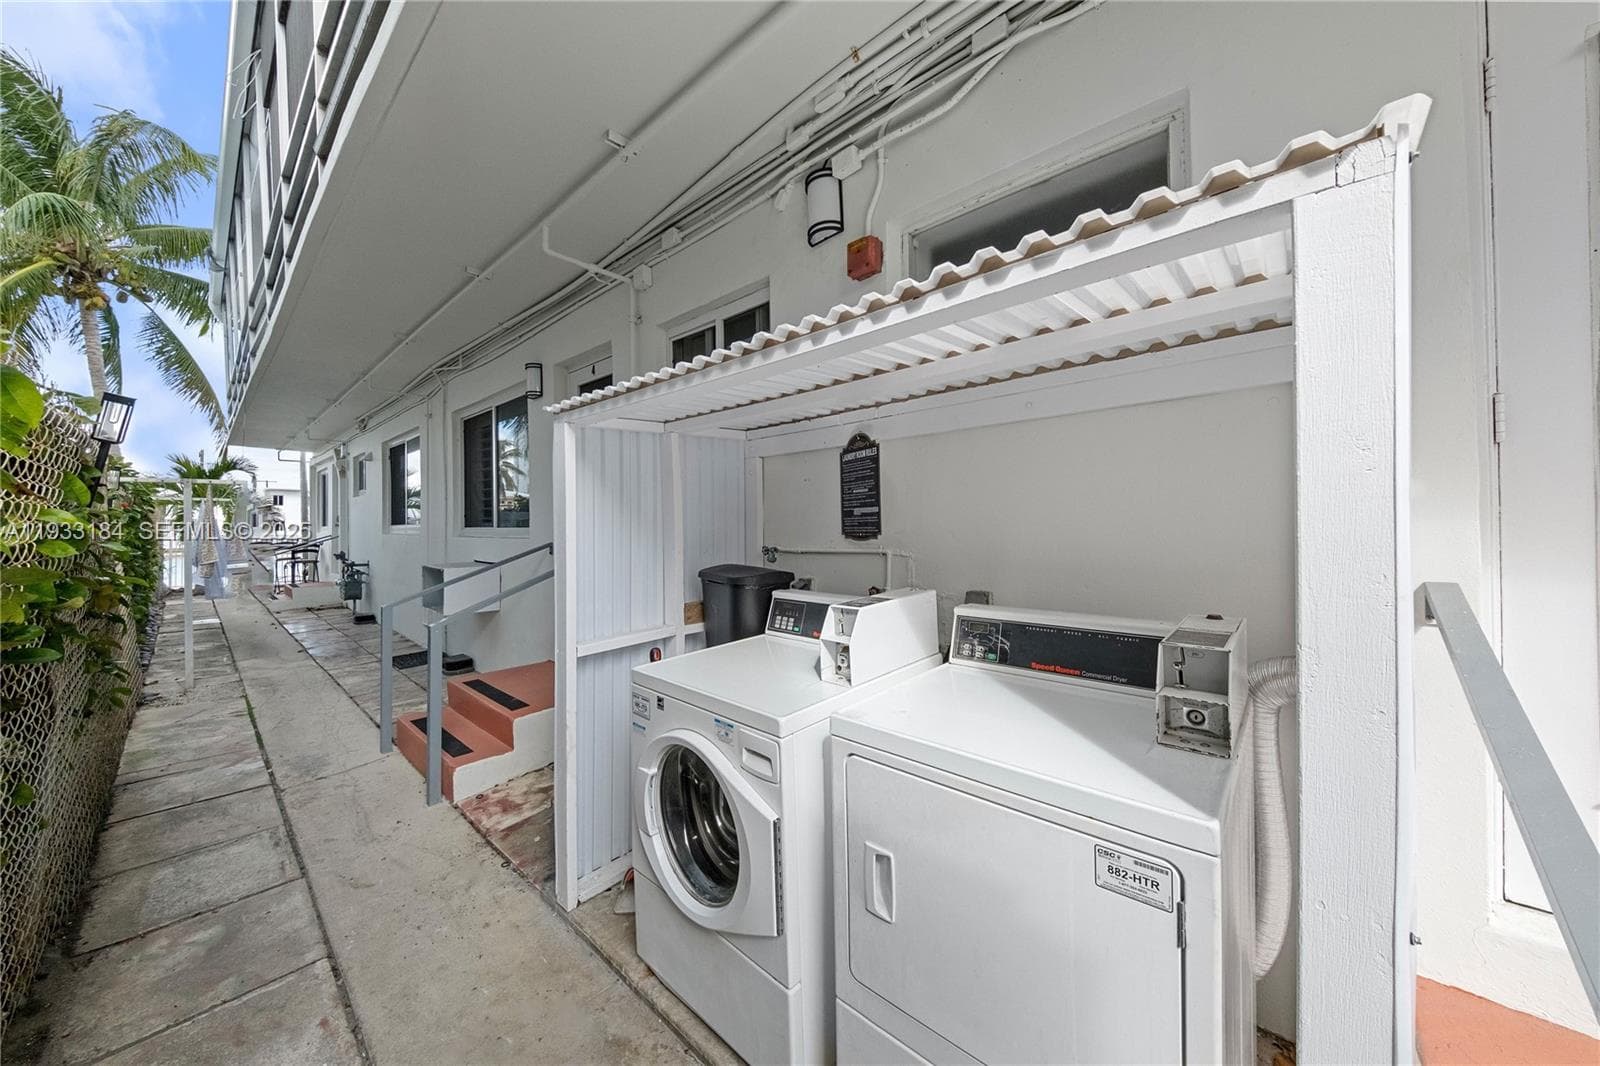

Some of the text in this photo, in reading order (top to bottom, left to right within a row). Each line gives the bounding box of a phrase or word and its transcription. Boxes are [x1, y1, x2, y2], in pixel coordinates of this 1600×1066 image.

[1031, 662, 1128, 683] Speed Queen Commercial Dryer
[1097, 848, 1116, 858] CSC
[1107, 864, 1160, 892] 882-HTR
